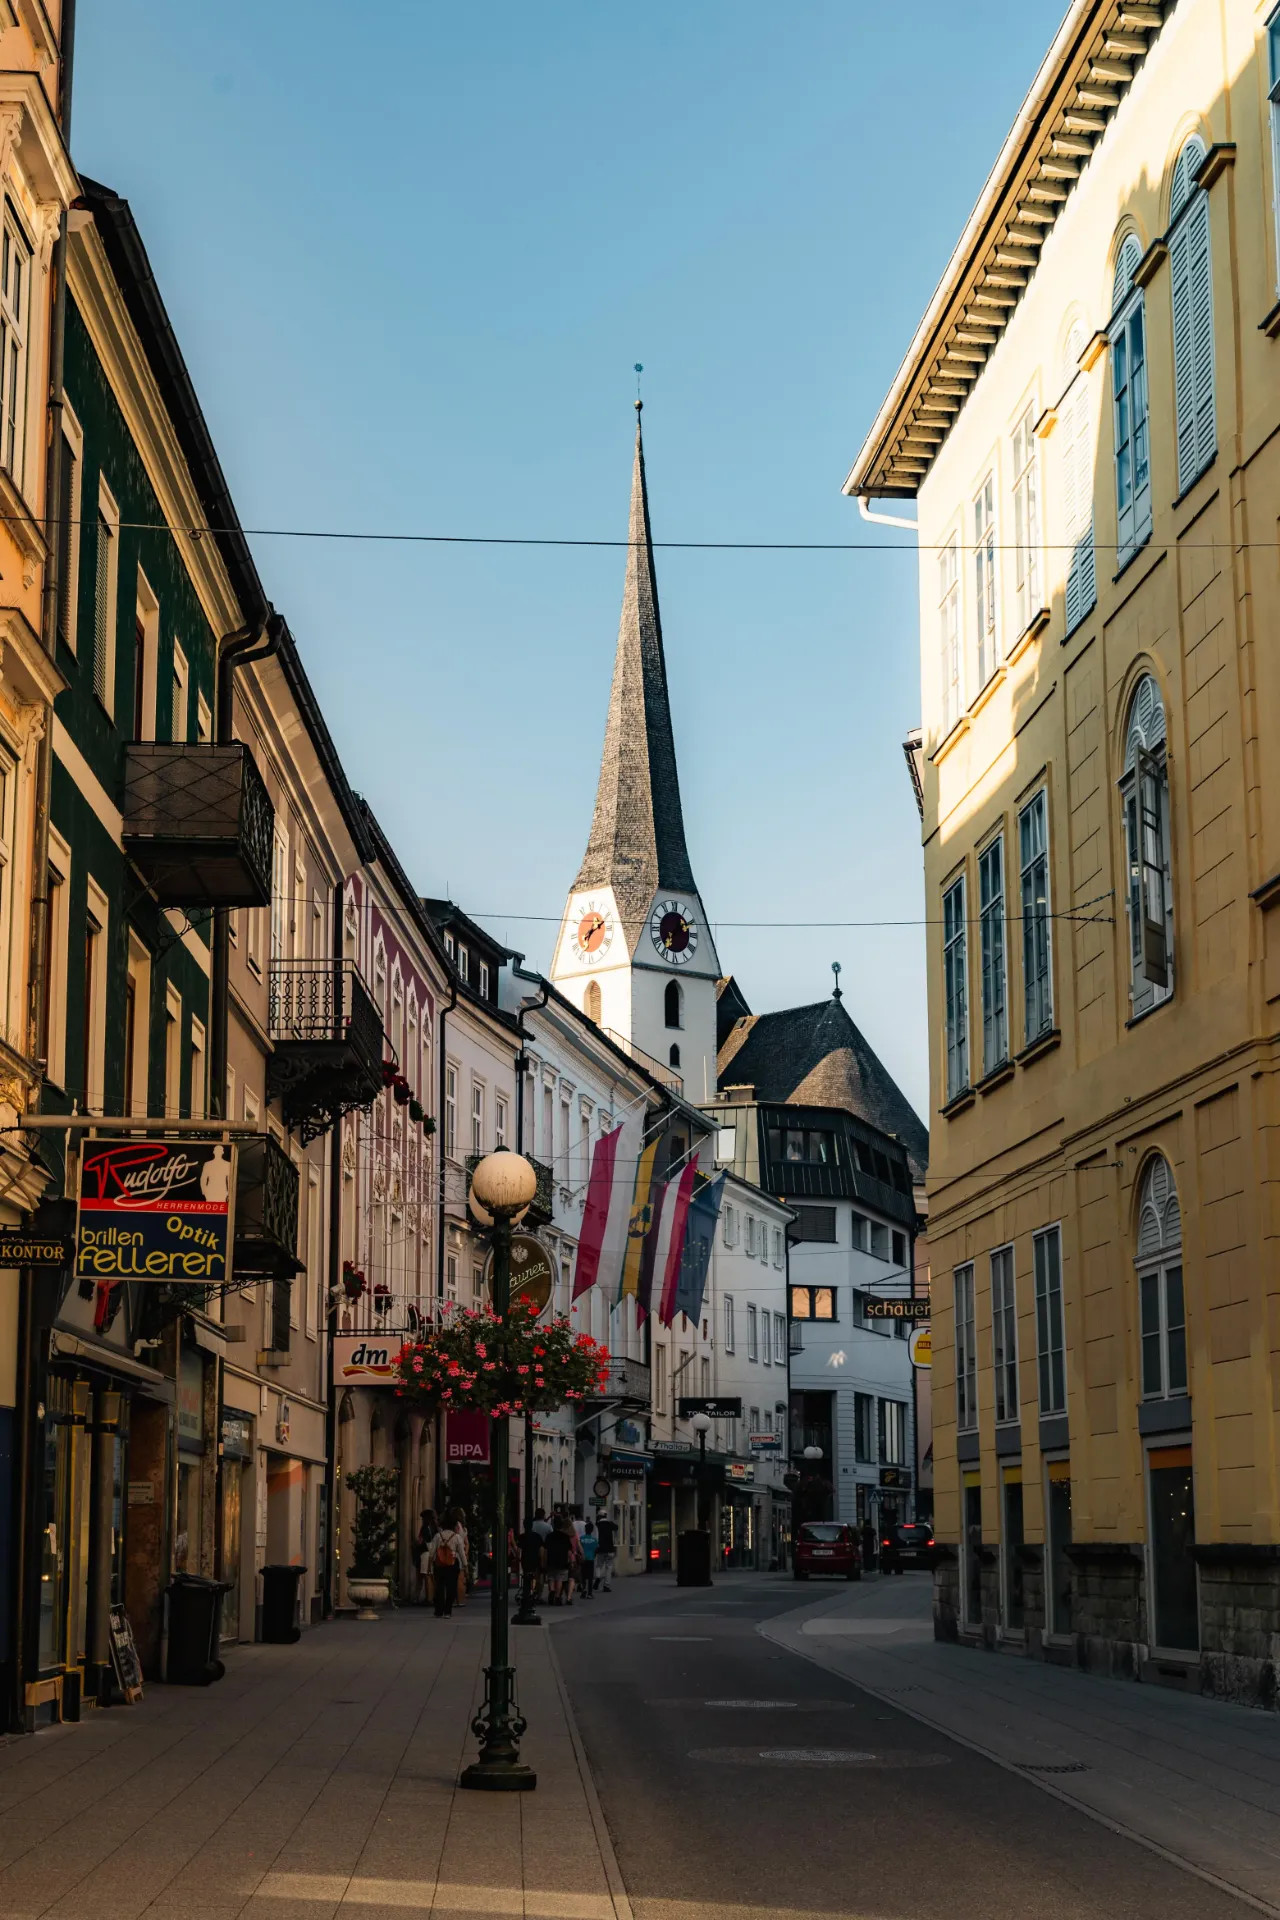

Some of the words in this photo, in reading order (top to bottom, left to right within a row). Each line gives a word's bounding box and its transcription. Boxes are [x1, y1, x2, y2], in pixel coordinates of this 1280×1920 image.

[84, 1144, 199, 1207] Rudolfo
[156, 1202, 226, 1211] HERRENMODE
[81, 1226, 144, 1247] brillen
[166, 1216, 220, 1251] Optik
[0, 1245, 65, 1260] KONTOR
[78, 1246, 225, 1276] fellerer
[351, 1343, 388, 1365] dm
[449, 1444, 483, 1457] BIPA
[612, 1467, 639, 1475] POLIZEI
